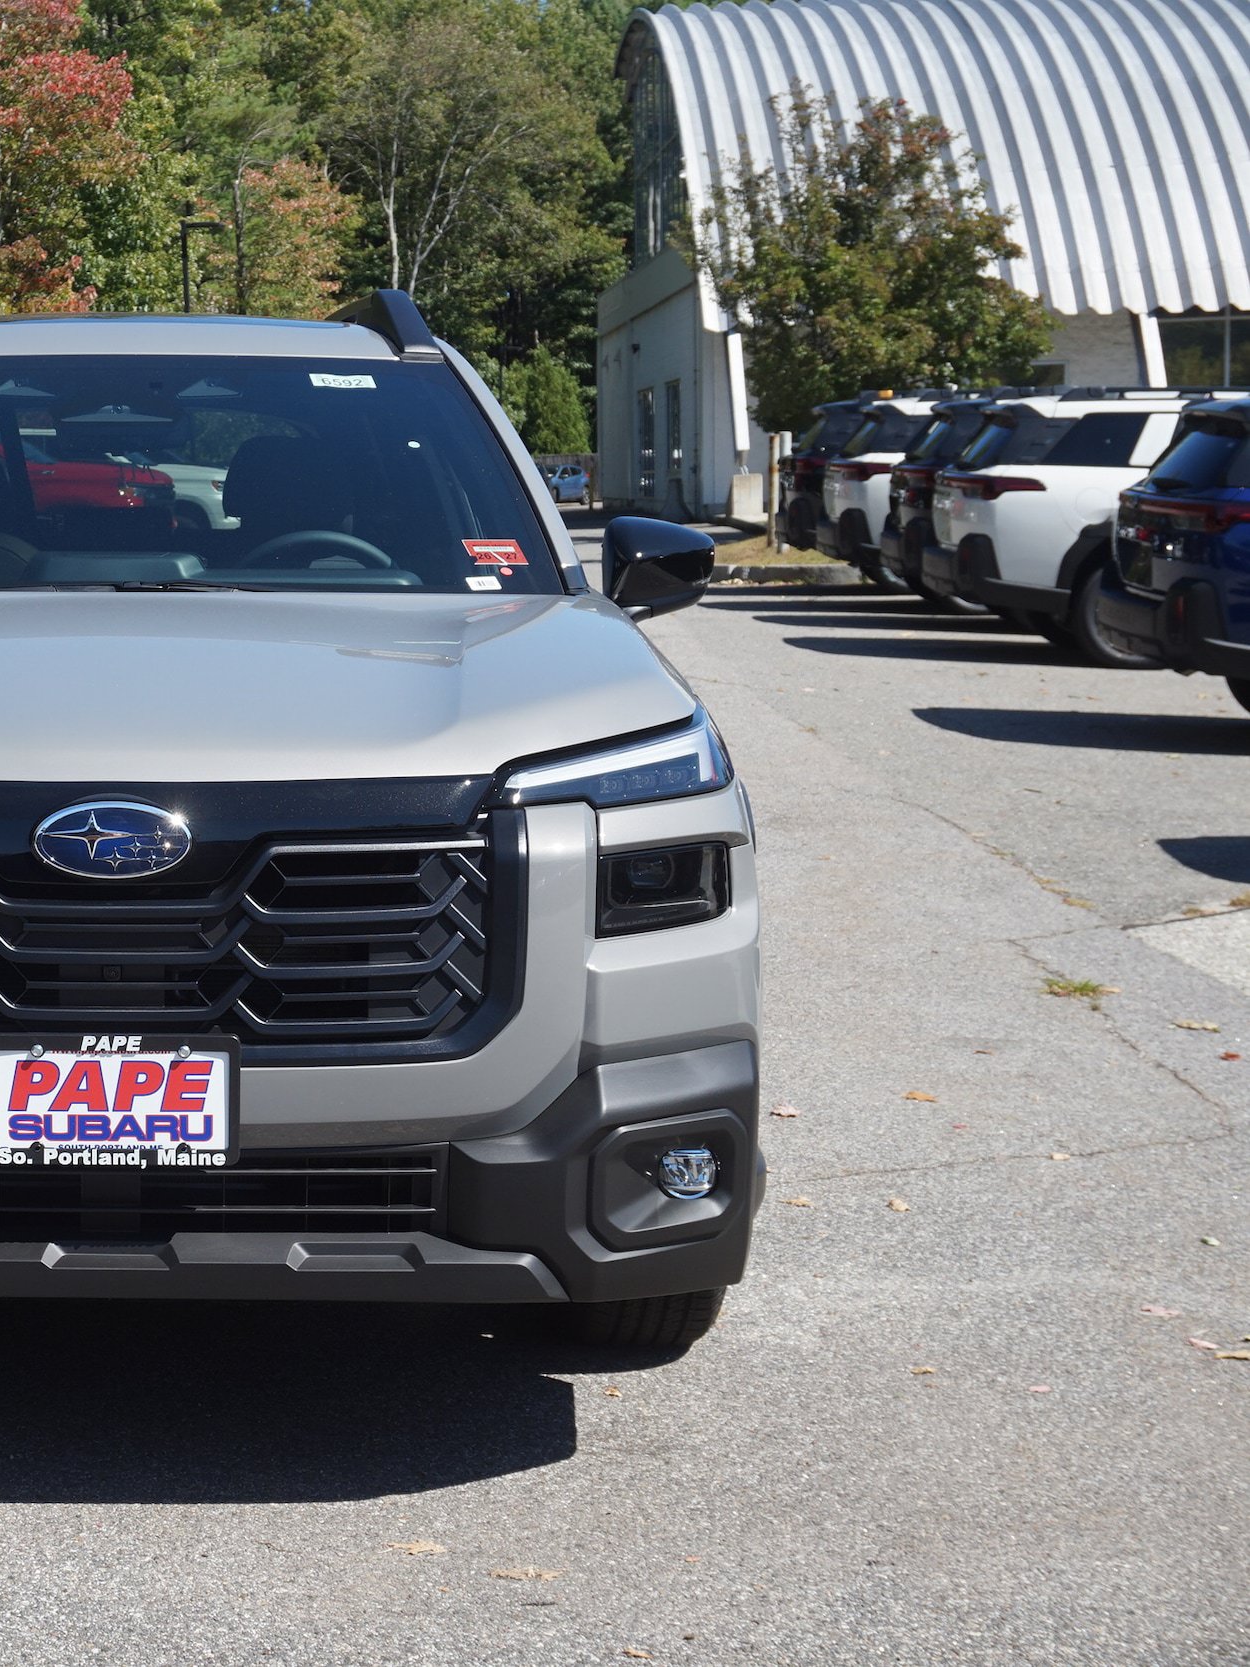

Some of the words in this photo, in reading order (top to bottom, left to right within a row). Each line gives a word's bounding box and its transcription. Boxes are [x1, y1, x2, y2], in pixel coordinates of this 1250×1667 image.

[321, 377, 363, 387] 6592
[476, 552, 492, 560] 26
[504, 552, 517, 560] 27
[80, 1035, 143, 1051] PAPE
[7, 1060, 214, 1112] PAPE
[8, 1113, 214, 1142] SUBARU
[43, 1148, 147, 1169] Portland,
[157, 1148, 227, 1166] Maine
